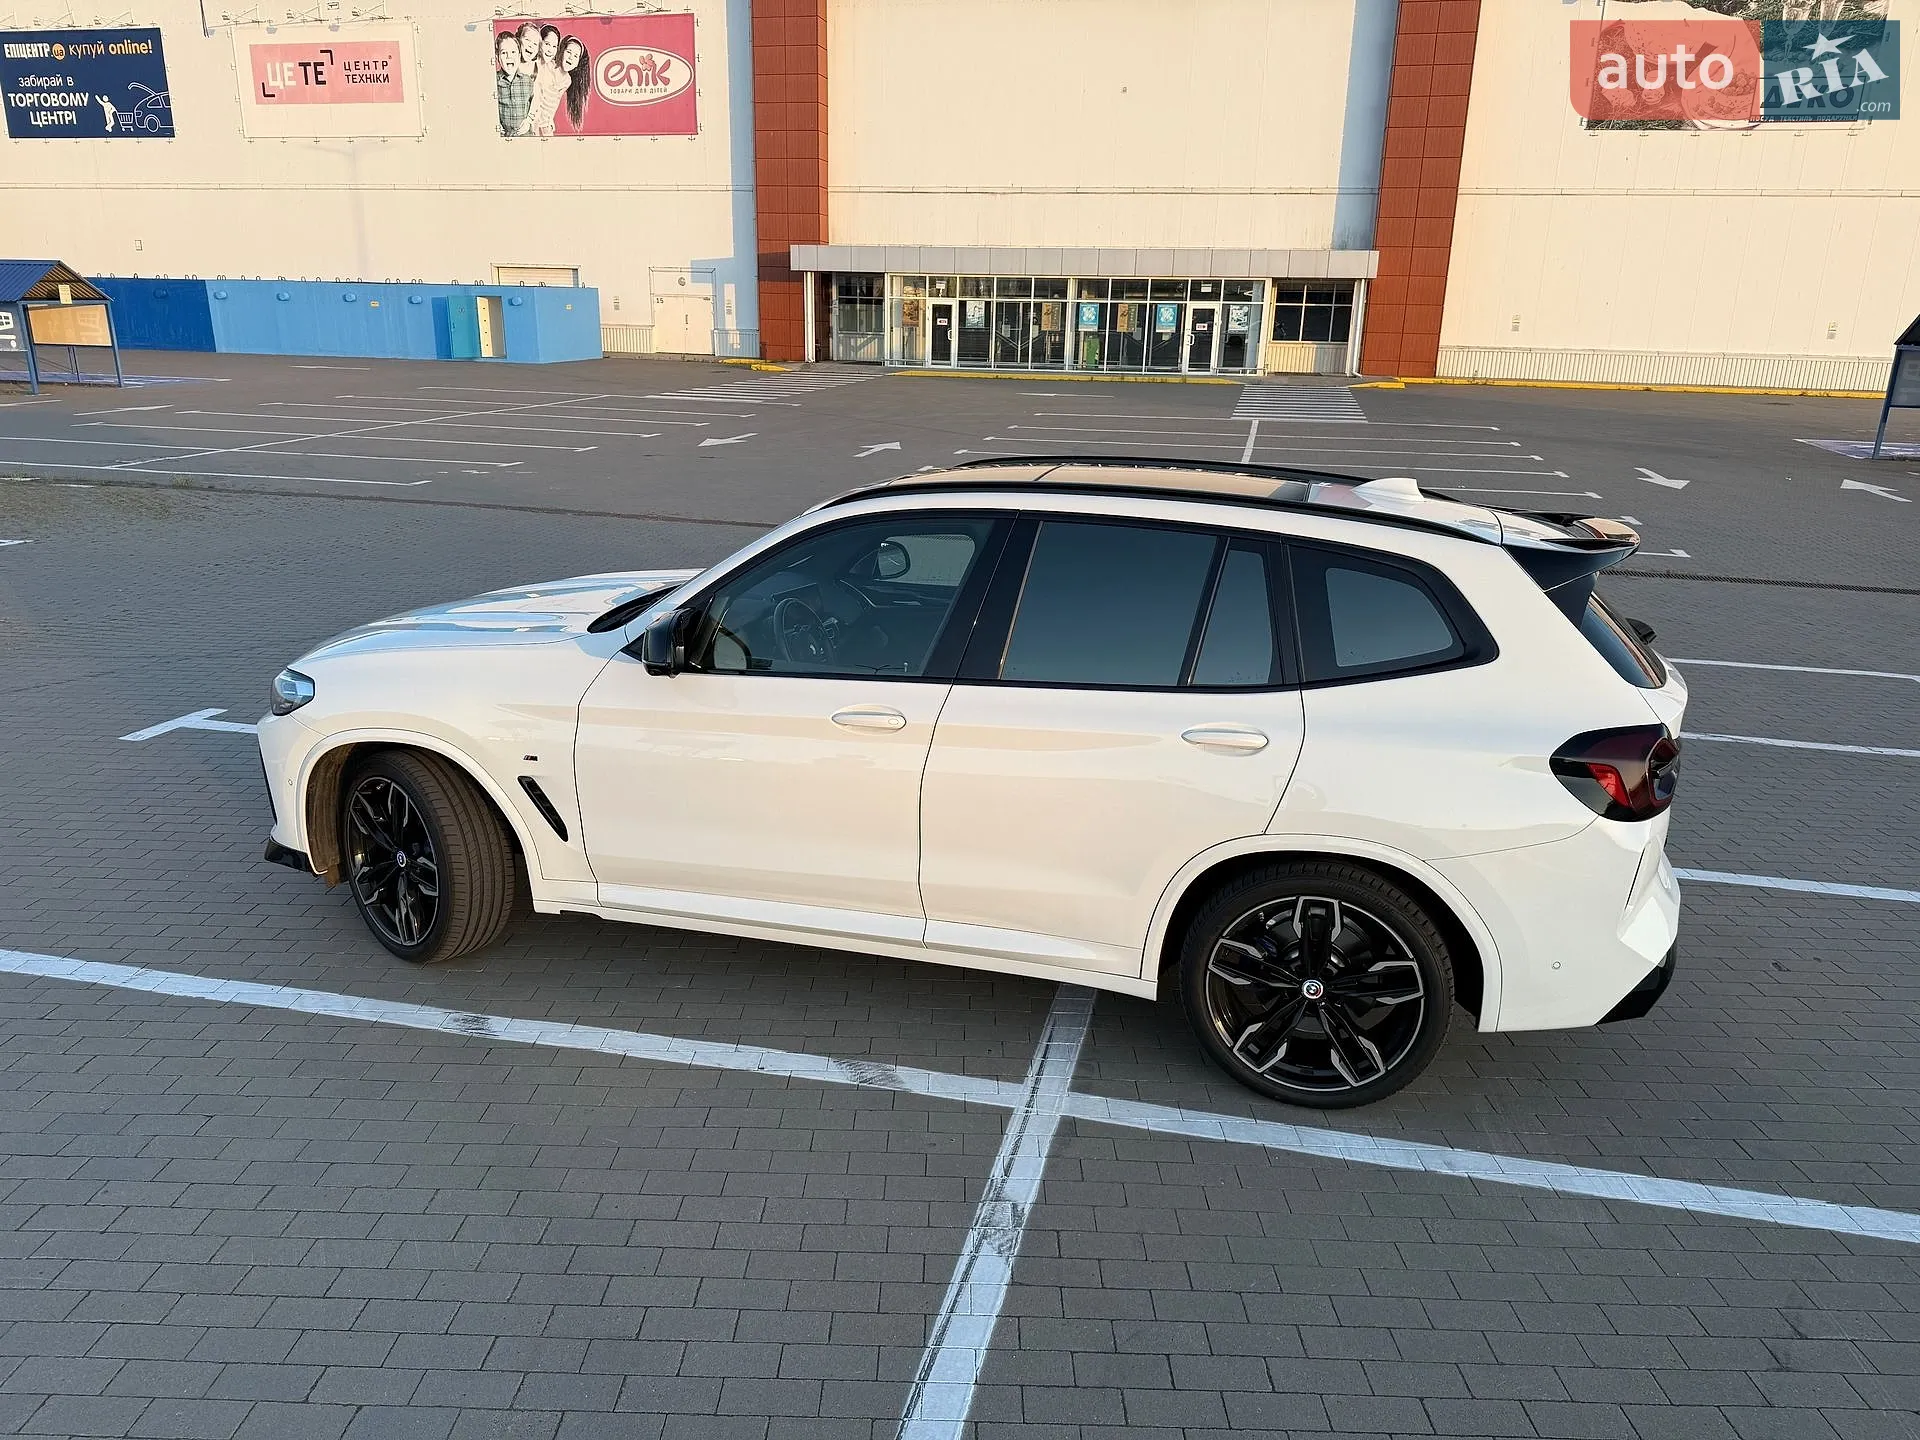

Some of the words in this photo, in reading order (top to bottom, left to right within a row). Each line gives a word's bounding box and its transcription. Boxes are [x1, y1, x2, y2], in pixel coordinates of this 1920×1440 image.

[68, 41, 105, 59] купуй
[108, 39, 153, 55] online!
[343, 60, 389, 73] ЦЕНТР
[18, 73, 63, 90] забирай
[66, 77, 74, 87] в
[344, 74, 390, 84] ТЕХНІКИ
[8, 92, 89, 107] ТОРГОВОМУ
[30, 110, 78, 128] ЦЕНТРІ
